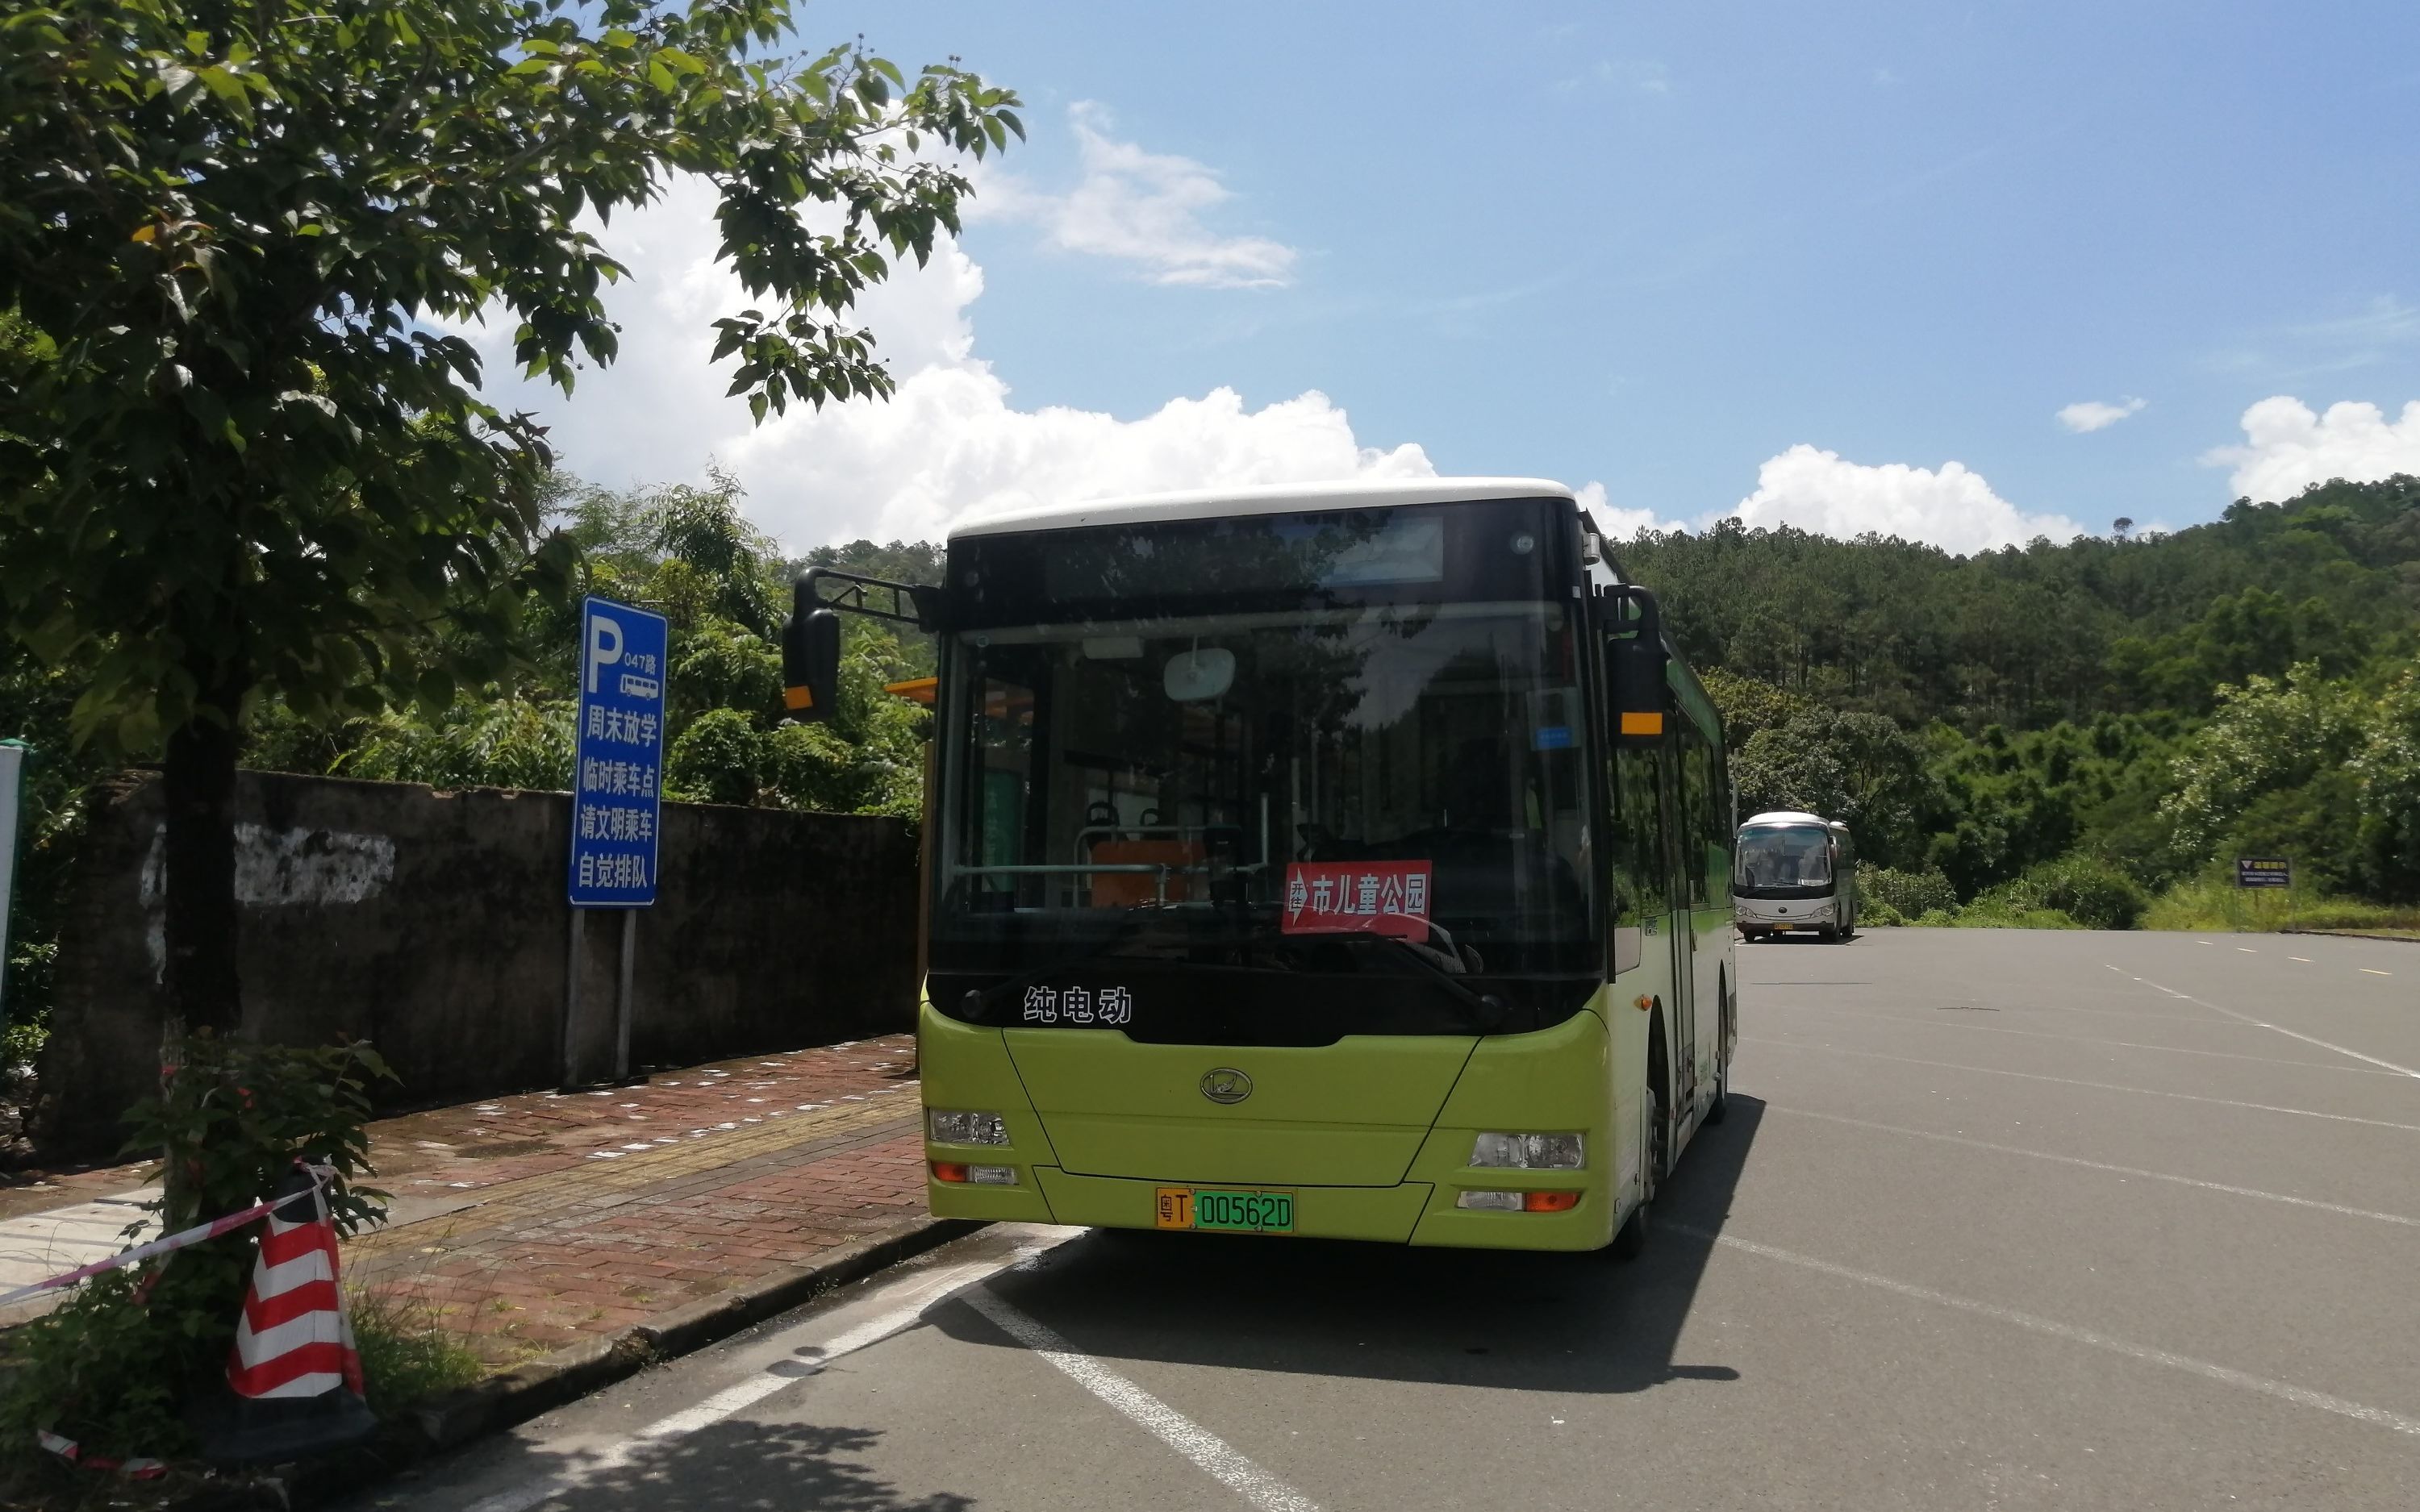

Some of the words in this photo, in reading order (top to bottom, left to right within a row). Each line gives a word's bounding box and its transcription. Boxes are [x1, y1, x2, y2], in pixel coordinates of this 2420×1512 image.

[589, 614, 623, 693] P
[624, 652, 656, 675] 047路
[587, 705, 657, 748] 周末放学
[583, 756, 654, 798] 临时乘车点
[581, 804, 653, 843] 请文明乘车
[579, 852, 648, 888] 自觉排队
[1291, 883, 1304, 910] 开往
[1312, 873, 1426, 915] 市儿童公园
[1024, 986, 1131, 1024] 纯电动
